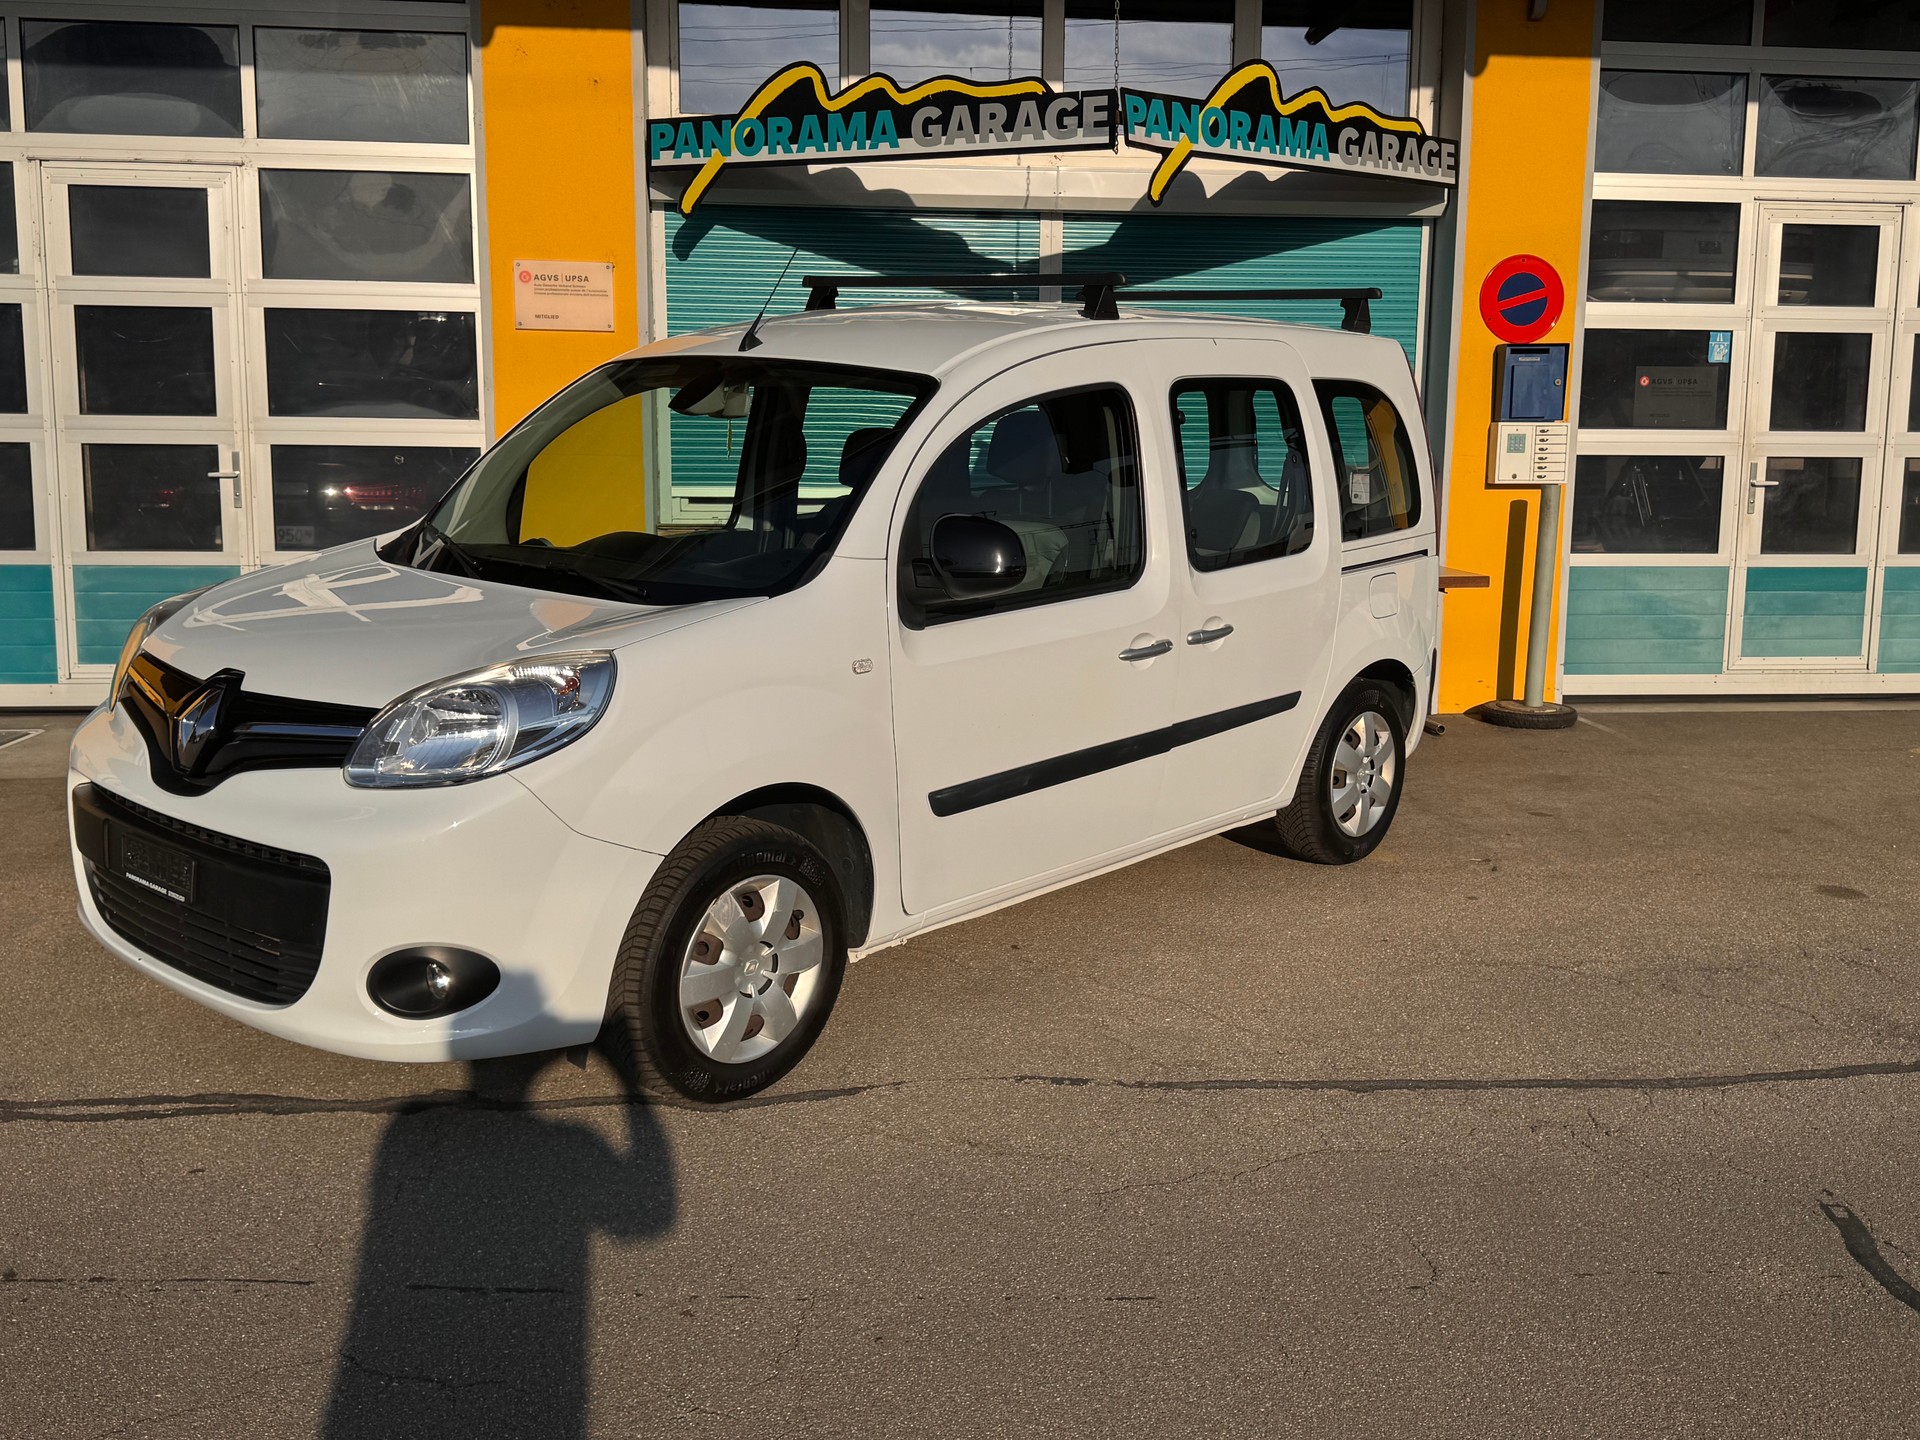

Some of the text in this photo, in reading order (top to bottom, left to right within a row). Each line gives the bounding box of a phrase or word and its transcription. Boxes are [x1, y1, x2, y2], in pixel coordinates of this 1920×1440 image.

[650, 95, 1109, 160] PANORAMA GARAGE
[1124, 94, 1456, 178] PANORAMA GARAGE
[533, 274, 559, 282] AGVS
